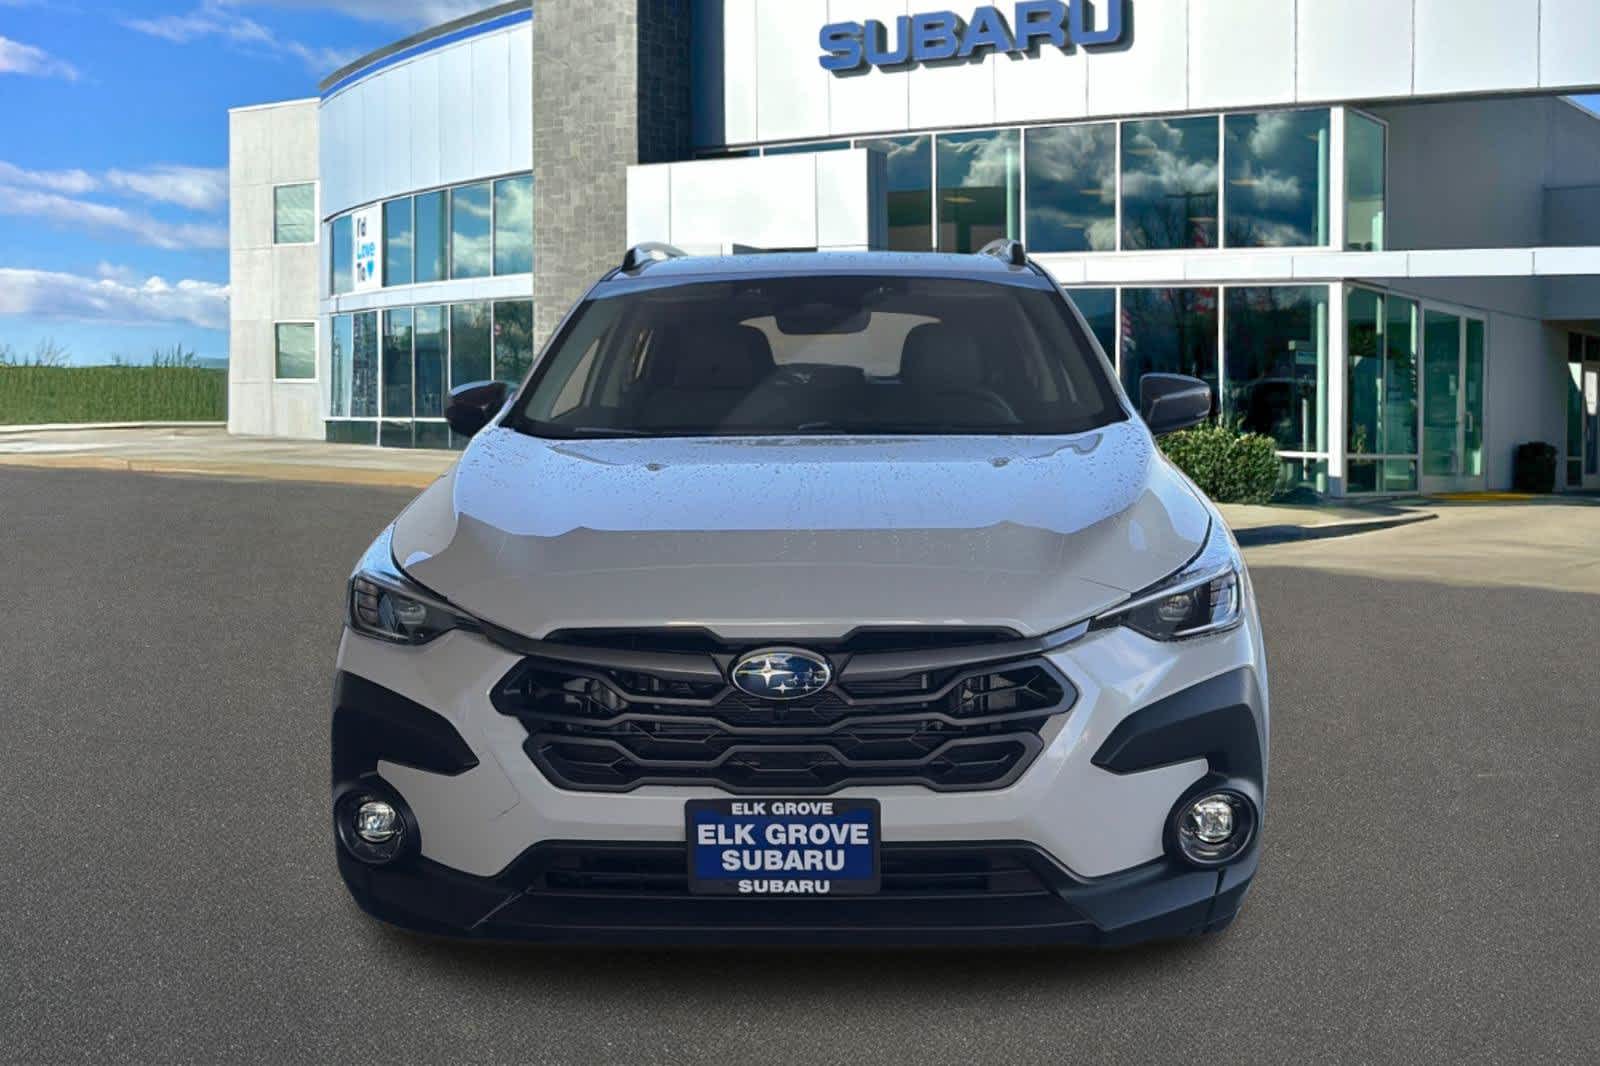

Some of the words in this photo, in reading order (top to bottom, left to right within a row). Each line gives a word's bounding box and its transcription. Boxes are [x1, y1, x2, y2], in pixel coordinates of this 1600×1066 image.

[818, 0, 1122, 71] SUBARU
[731, 803, 766, 815] ELK
[771, 803, 833, 815] GROVE
[697, 824, 756, 845] ELK
[765, 823, 869, 845] GROVE
[721, 849, 845, 871] SUBARU
[738, 880, 830, 893] SUBARU
